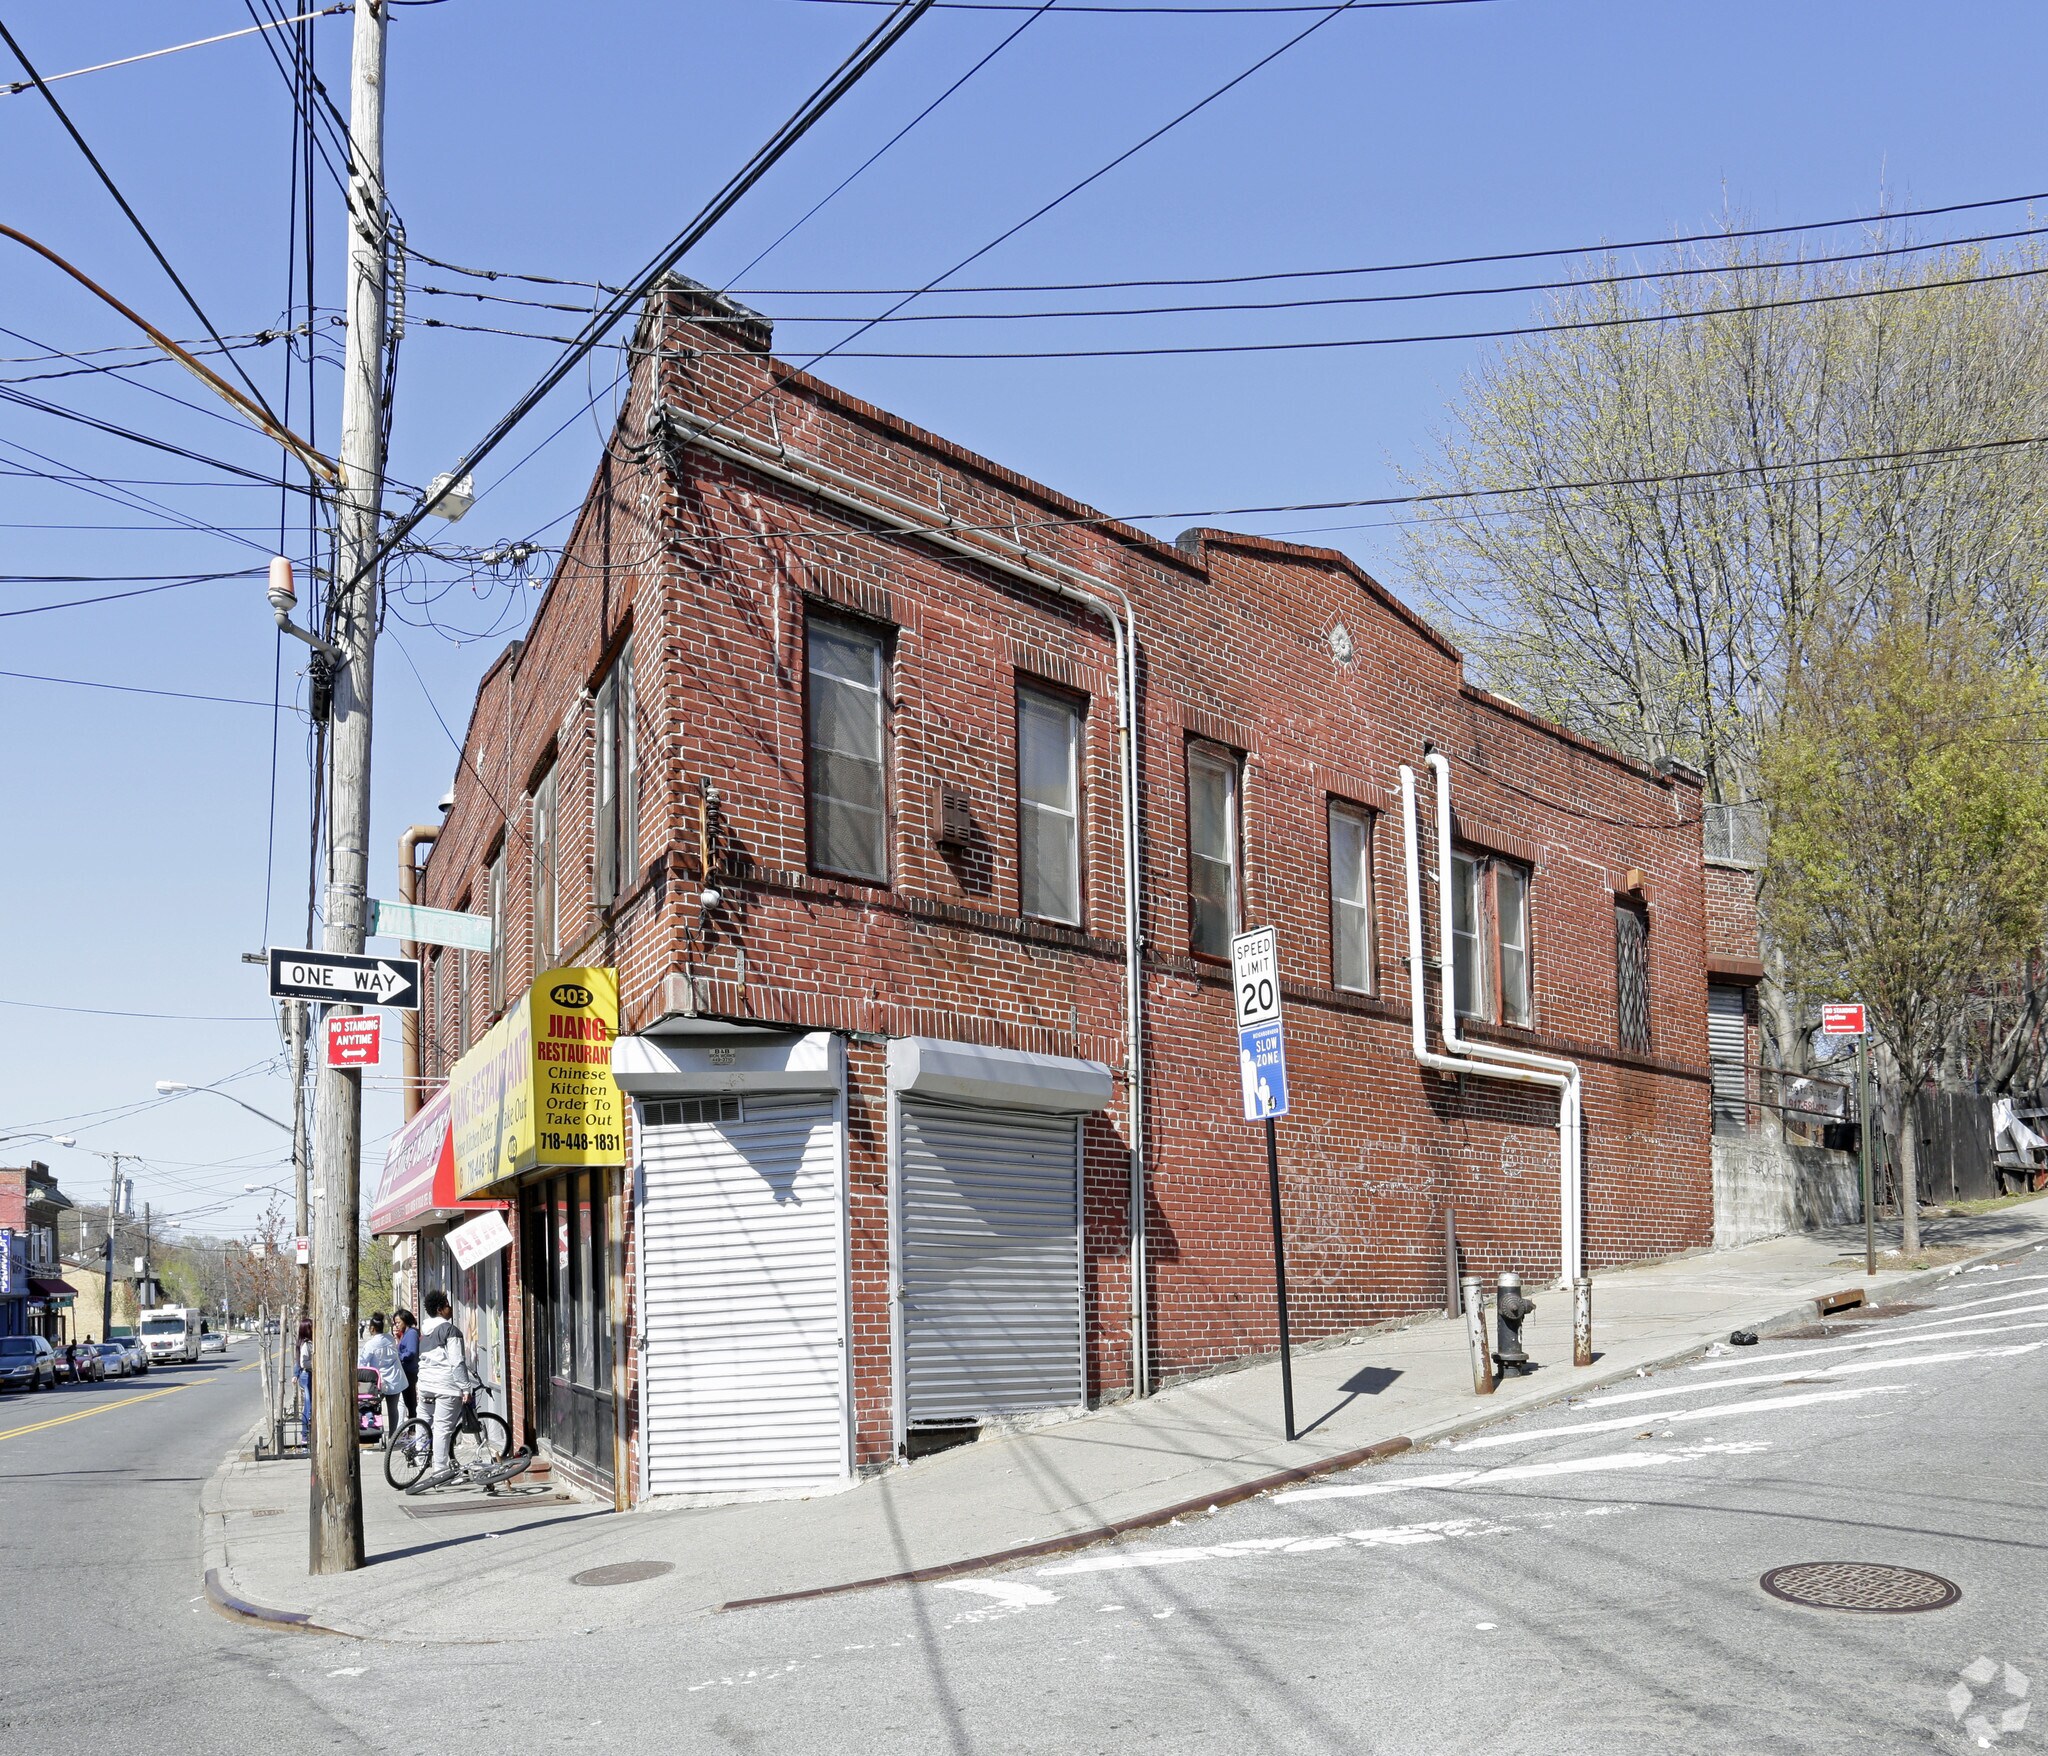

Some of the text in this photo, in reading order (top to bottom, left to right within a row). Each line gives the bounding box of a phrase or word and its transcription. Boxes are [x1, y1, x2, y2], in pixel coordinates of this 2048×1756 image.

[1237, 938, 1271, 960] SPEED
[1241, 957, 1270, 978] LIMIT
[292, 965, 396, 992] ONE WAY
[554, 988, 589, 1005] 403
[1242, 978, 1274, 1016] 20
[331, 1019, 379, 1033] NO STANDING
[547, 1014, 607, 1042] JIANG
[336, 1033, 373, 1046] ANYTIME
[1256, 1036, 1277, 1053] SLOW
[537, 1041, 613, 1066] RESTAURANT
[1256, 1051, 1279, 1067] ZONE
[548, 1066, 606, 1080] Chinese
[550, 1082, 607, 1096] Kitchen
[546, 1097, 611, 1111] Order To
[546, 1112, 612, 1126] Take Out
[540, 1132, 620, 1151] 718-448-1831
